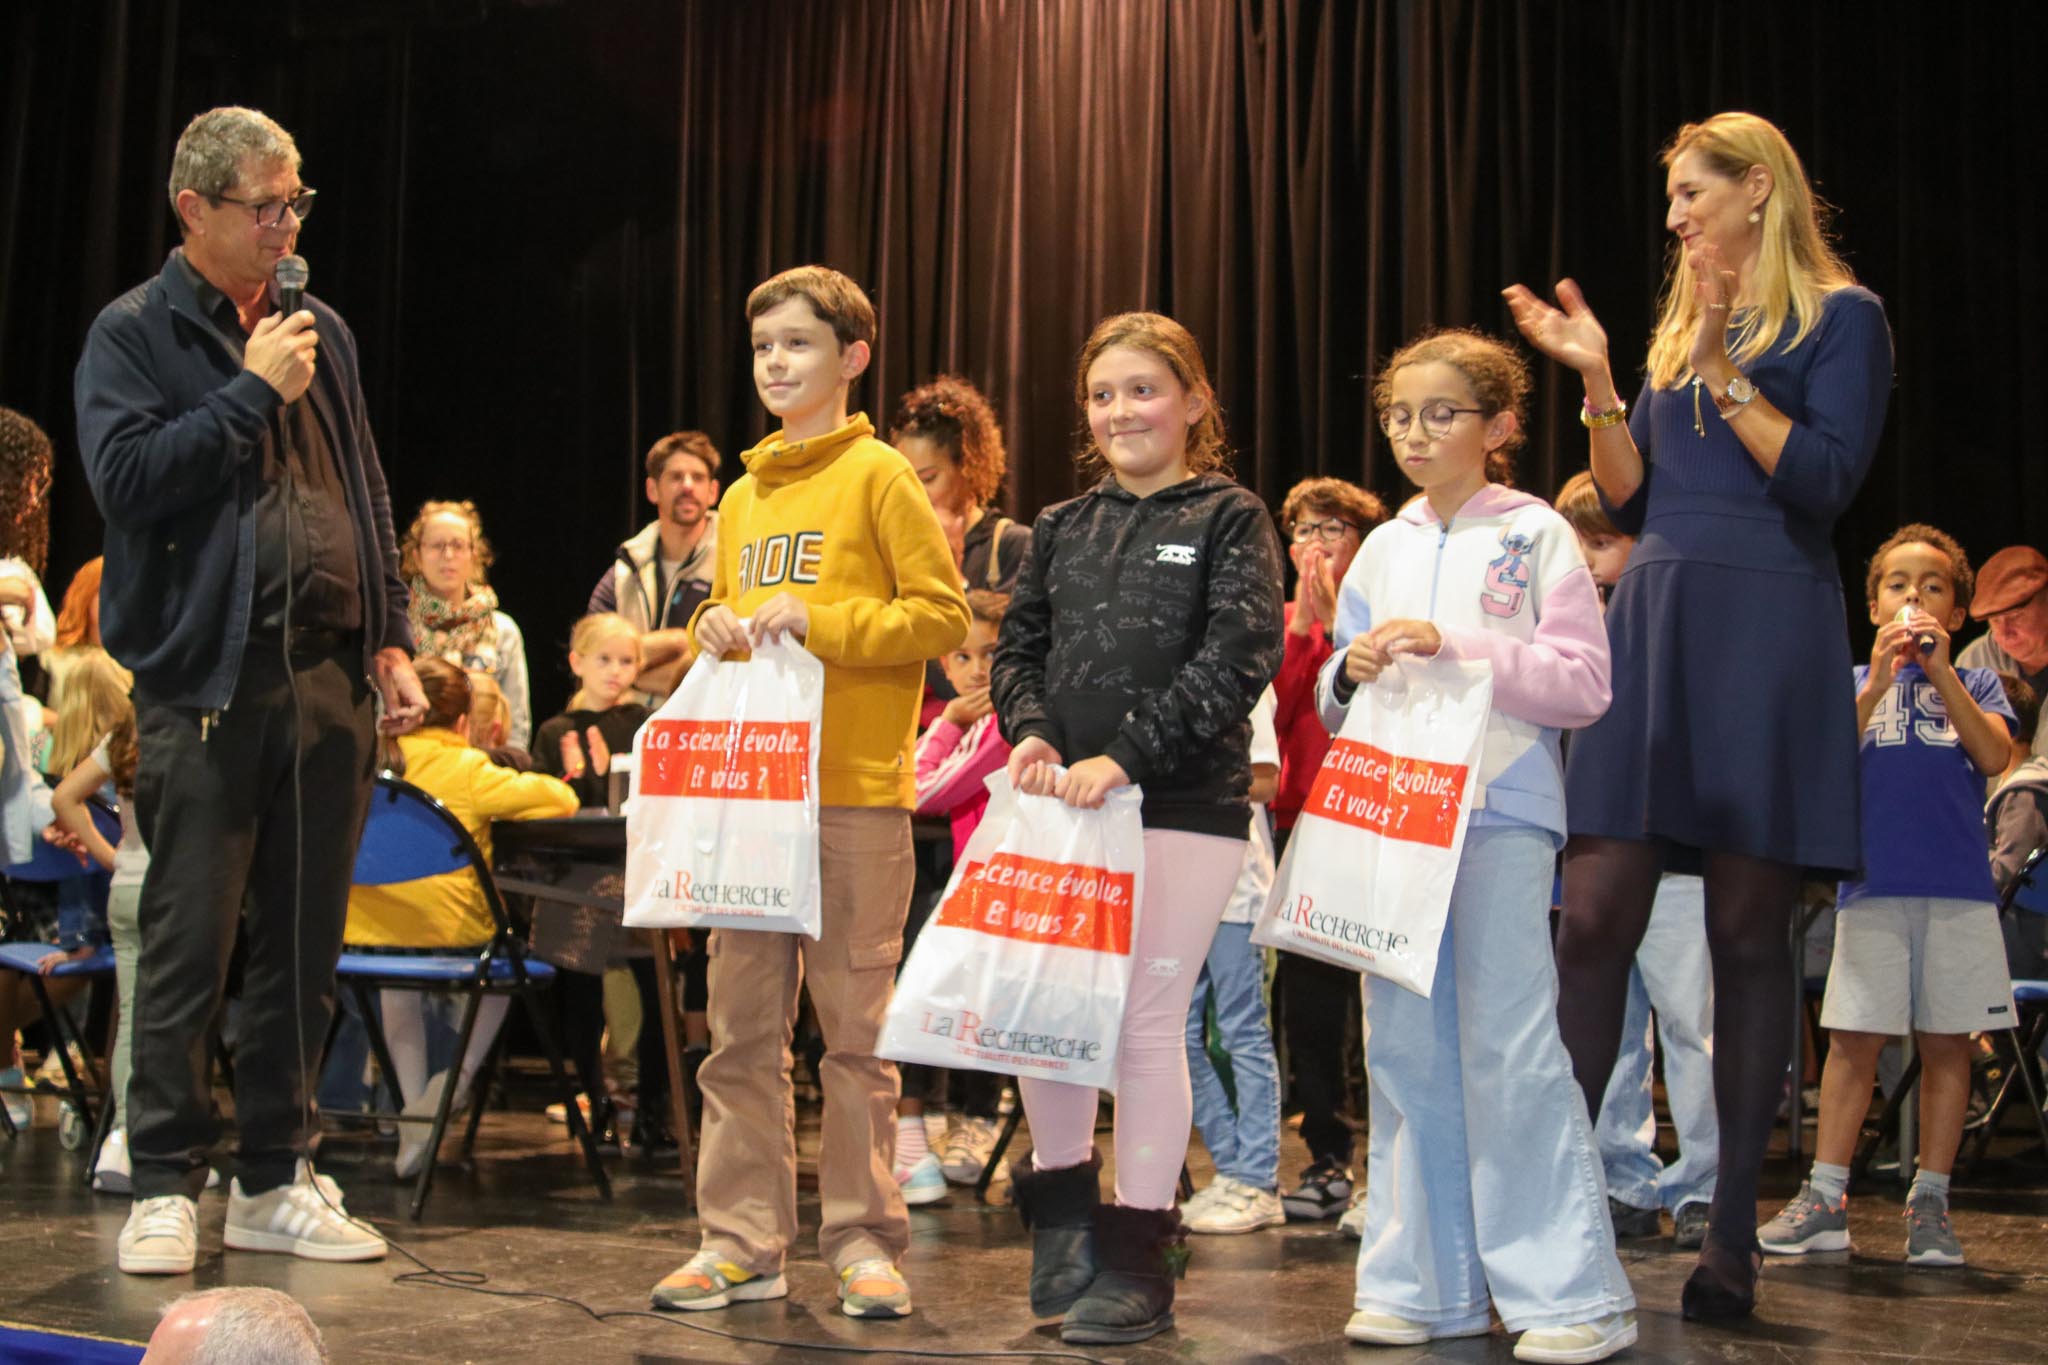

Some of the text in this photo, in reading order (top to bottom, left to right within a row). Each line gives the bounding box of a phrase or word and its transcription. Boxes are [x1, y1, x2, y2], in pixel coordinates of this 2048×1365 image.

[757, 766, 769, 791] ?
[1323, 784, 1409, 830] Et vous ?
[1011, 908, 1064, 935] vous
[1069, 912, 1087, 937] ?
